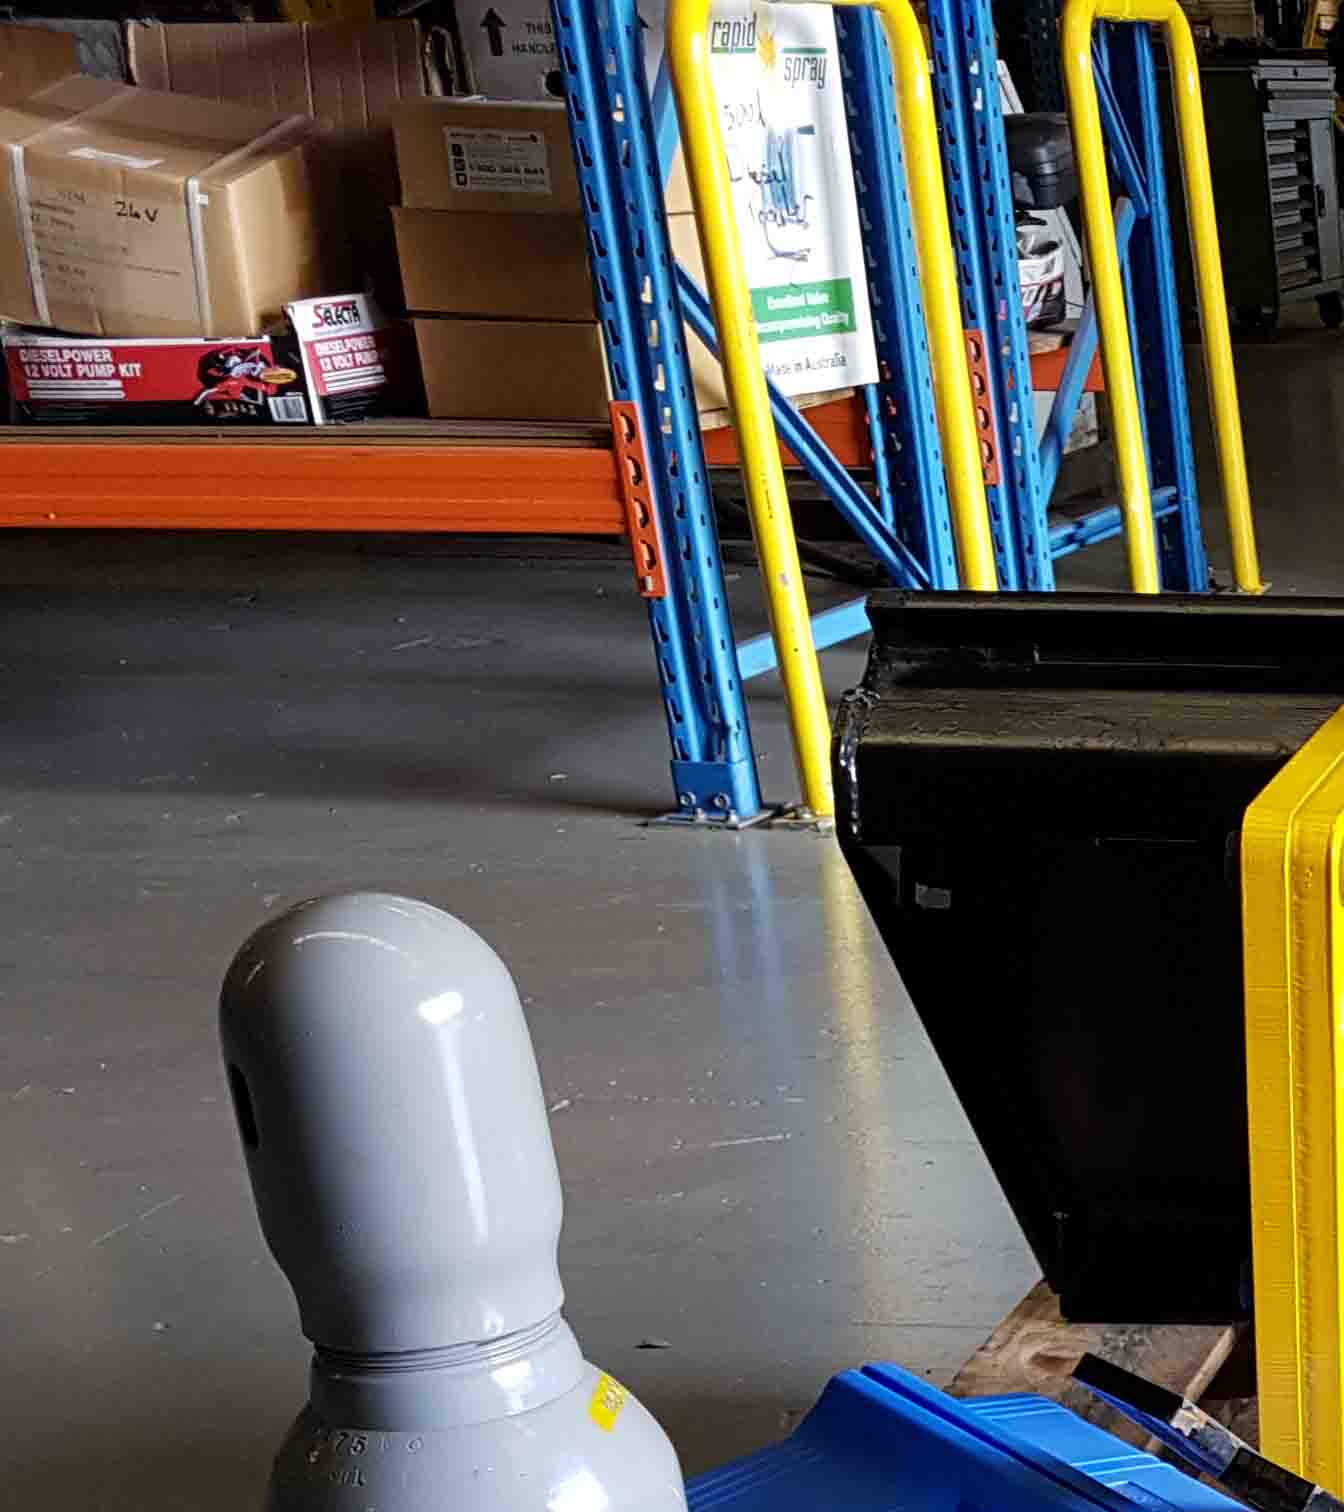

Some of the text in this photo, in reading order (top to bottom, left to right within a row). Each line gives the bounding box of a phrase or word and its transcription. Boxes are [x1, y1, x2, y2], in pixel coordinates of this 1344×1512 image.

[712, 12, 756, 54] rapid
[784, 56, 827, 89] spray
[19, 349, 113, 362] DIESELPOWER
[24, 362, 142, 377] 12 VOLT PUMP KIT
